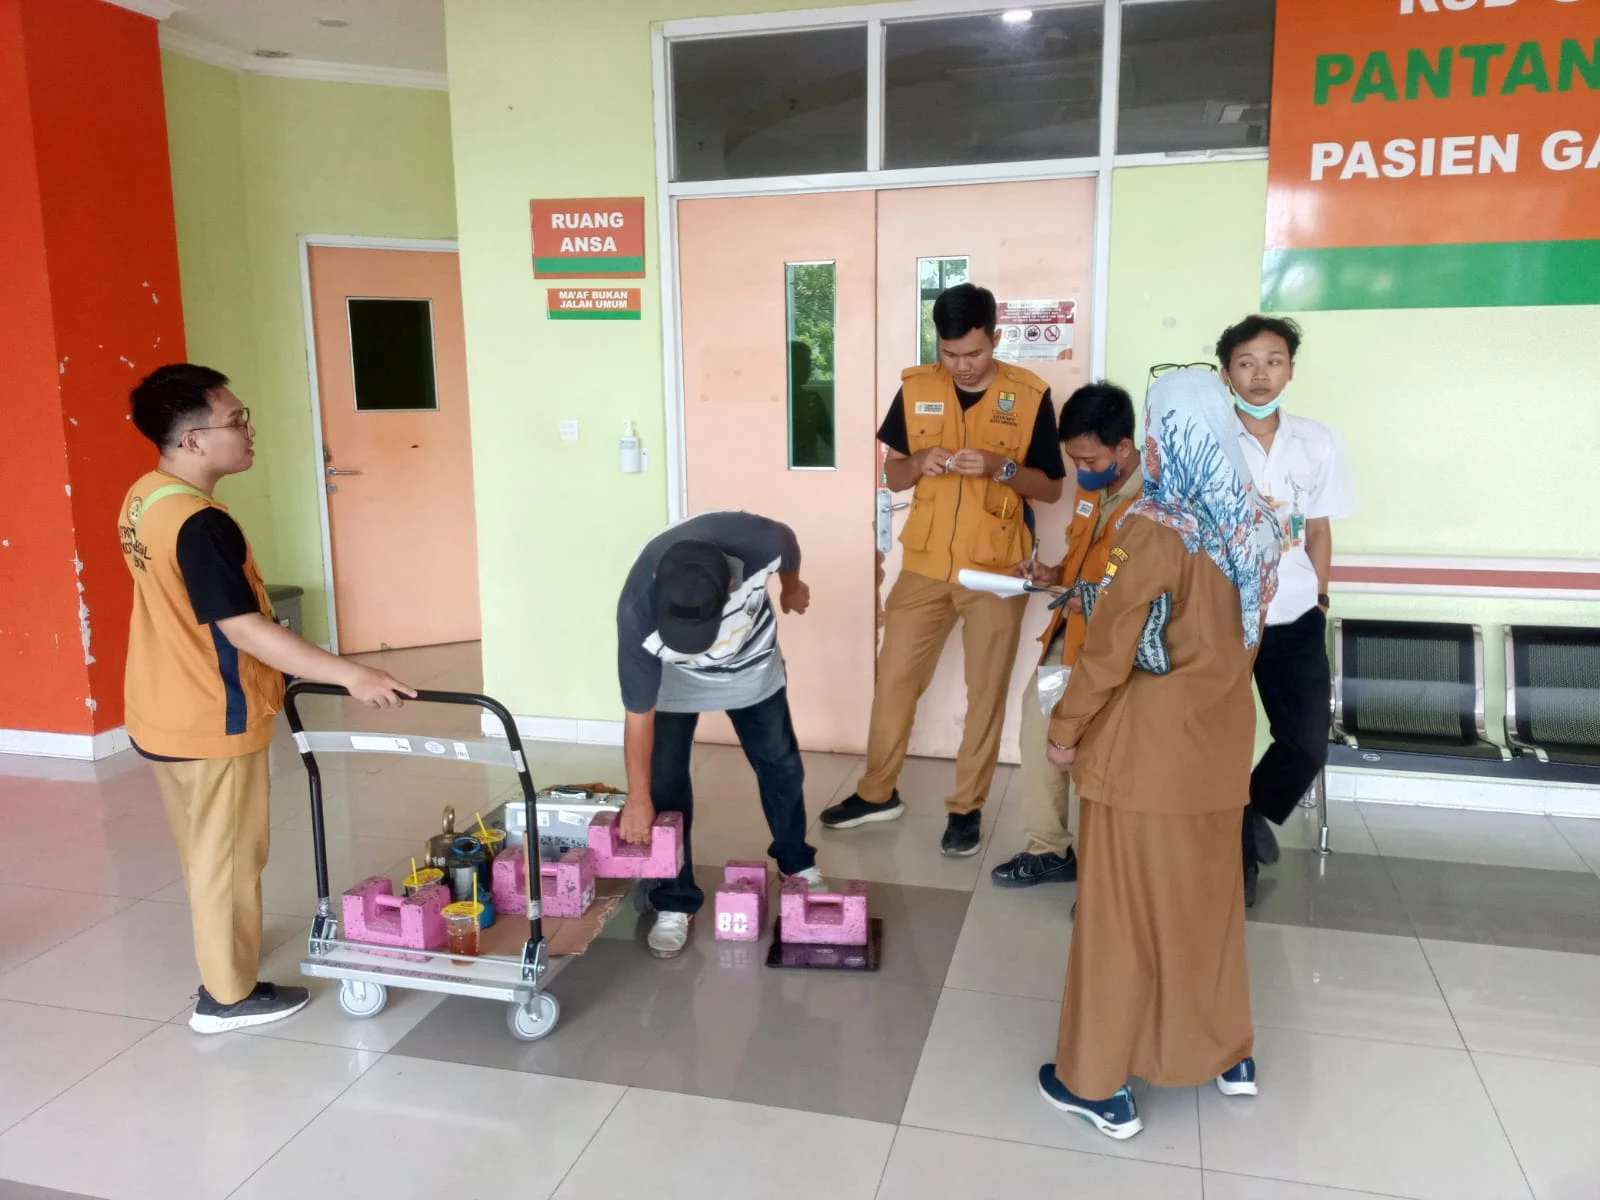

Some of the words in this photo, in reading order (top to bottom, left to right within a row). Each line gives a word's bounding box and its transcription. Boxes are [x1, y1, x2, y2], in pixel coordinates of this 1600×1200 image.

[1310, 133, 1519, 181] PASIEN
[551, 212, 624, 229] RUANG
[560, 236, 617, 252] ANSA
[559, 291, 589, 299] MA'AF
[592, 291, 627, 299] BUKAN
[560, 300, 592, 308] JALAN
[595, 300, 627, 308] UMUM
